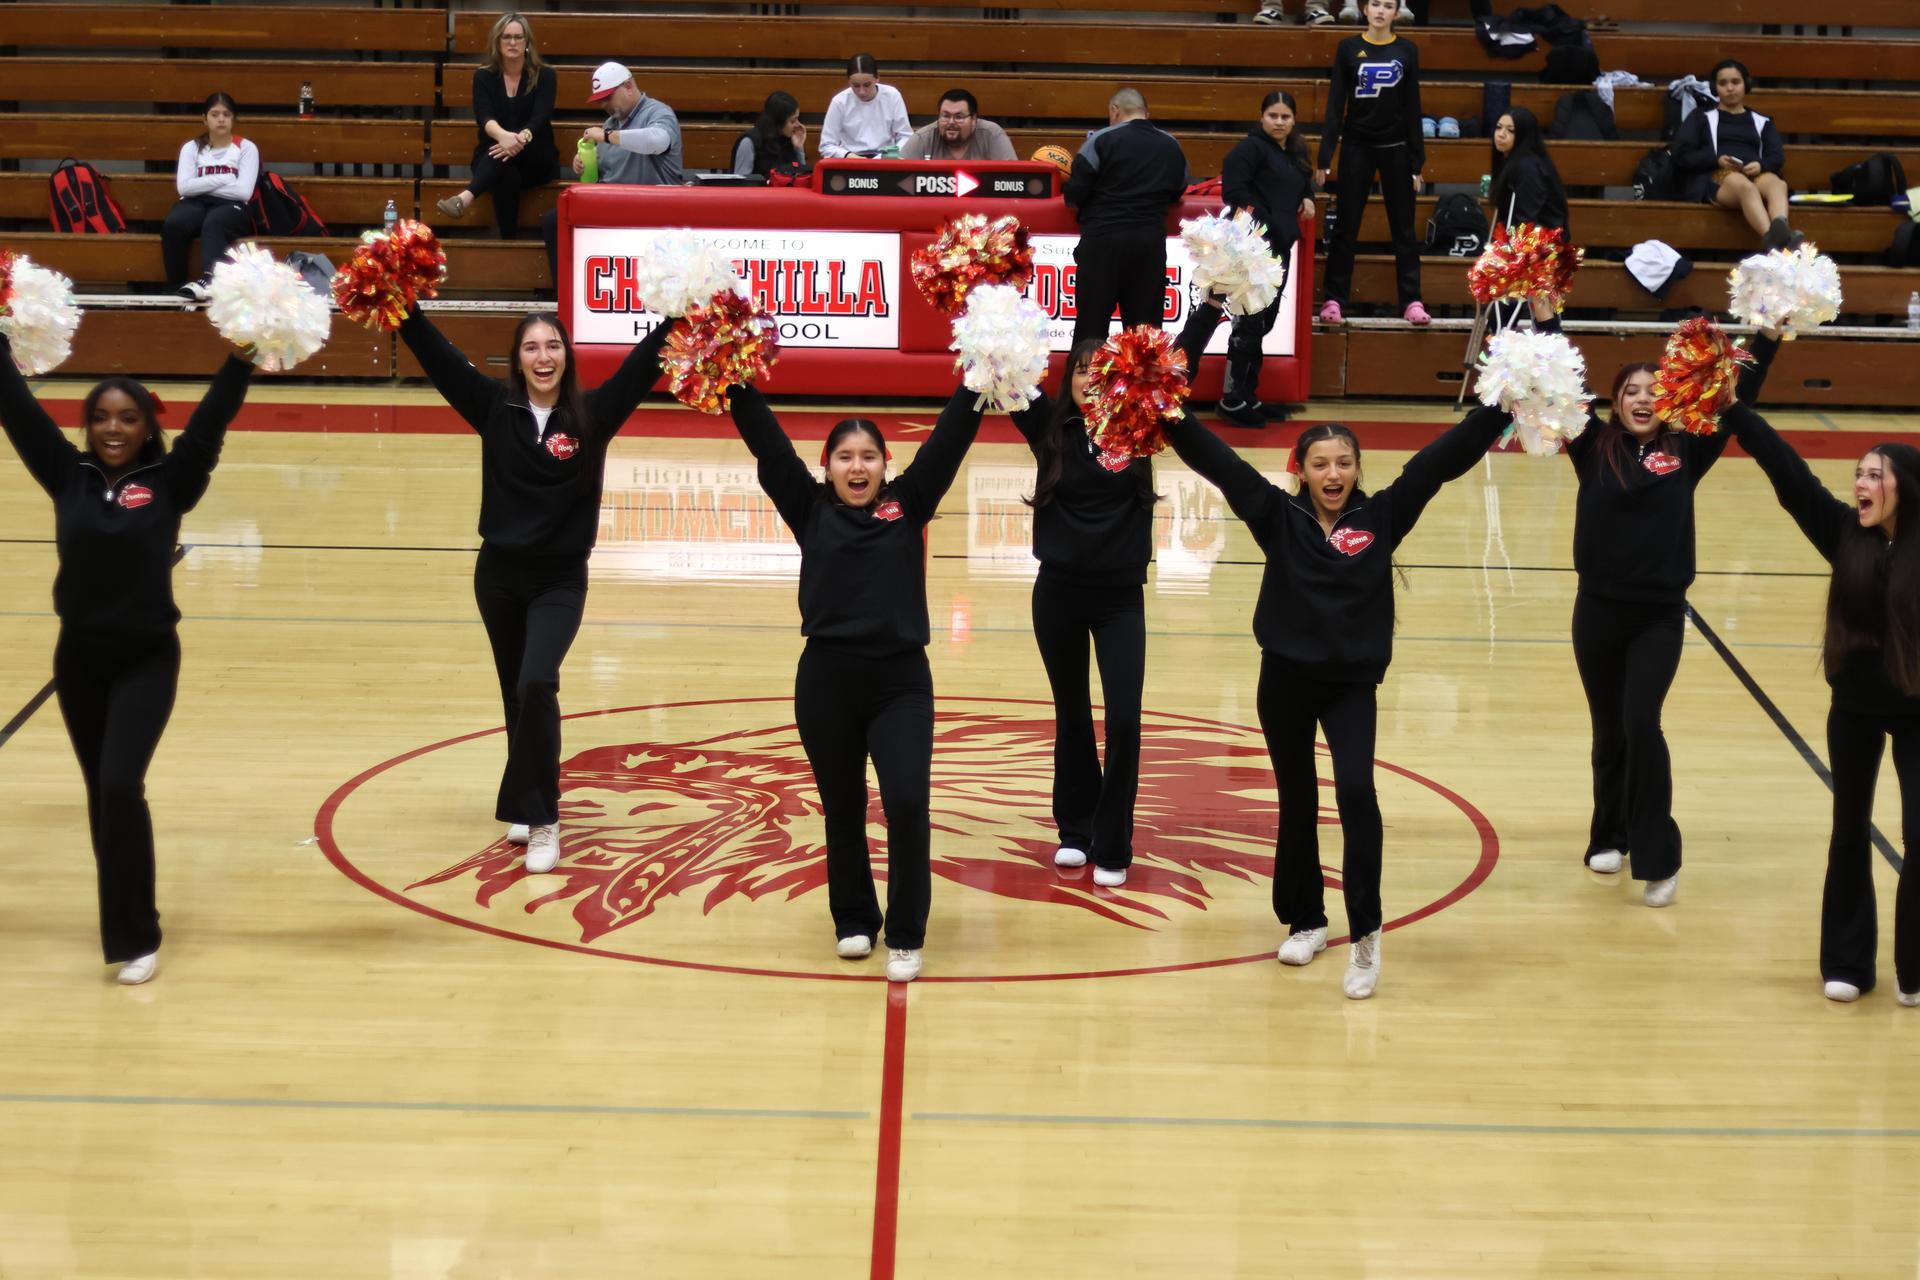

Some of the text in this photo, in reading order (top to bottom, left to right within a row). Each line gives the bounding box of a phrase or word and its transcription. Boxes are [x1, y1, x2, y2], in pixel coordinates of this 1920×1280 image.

[848, 177, 879, 190] BONUS
[915, 175, 957, 194] POSS
[994, 180, 1025, 193] BONUS
[778, 239, 804, 250] TO
